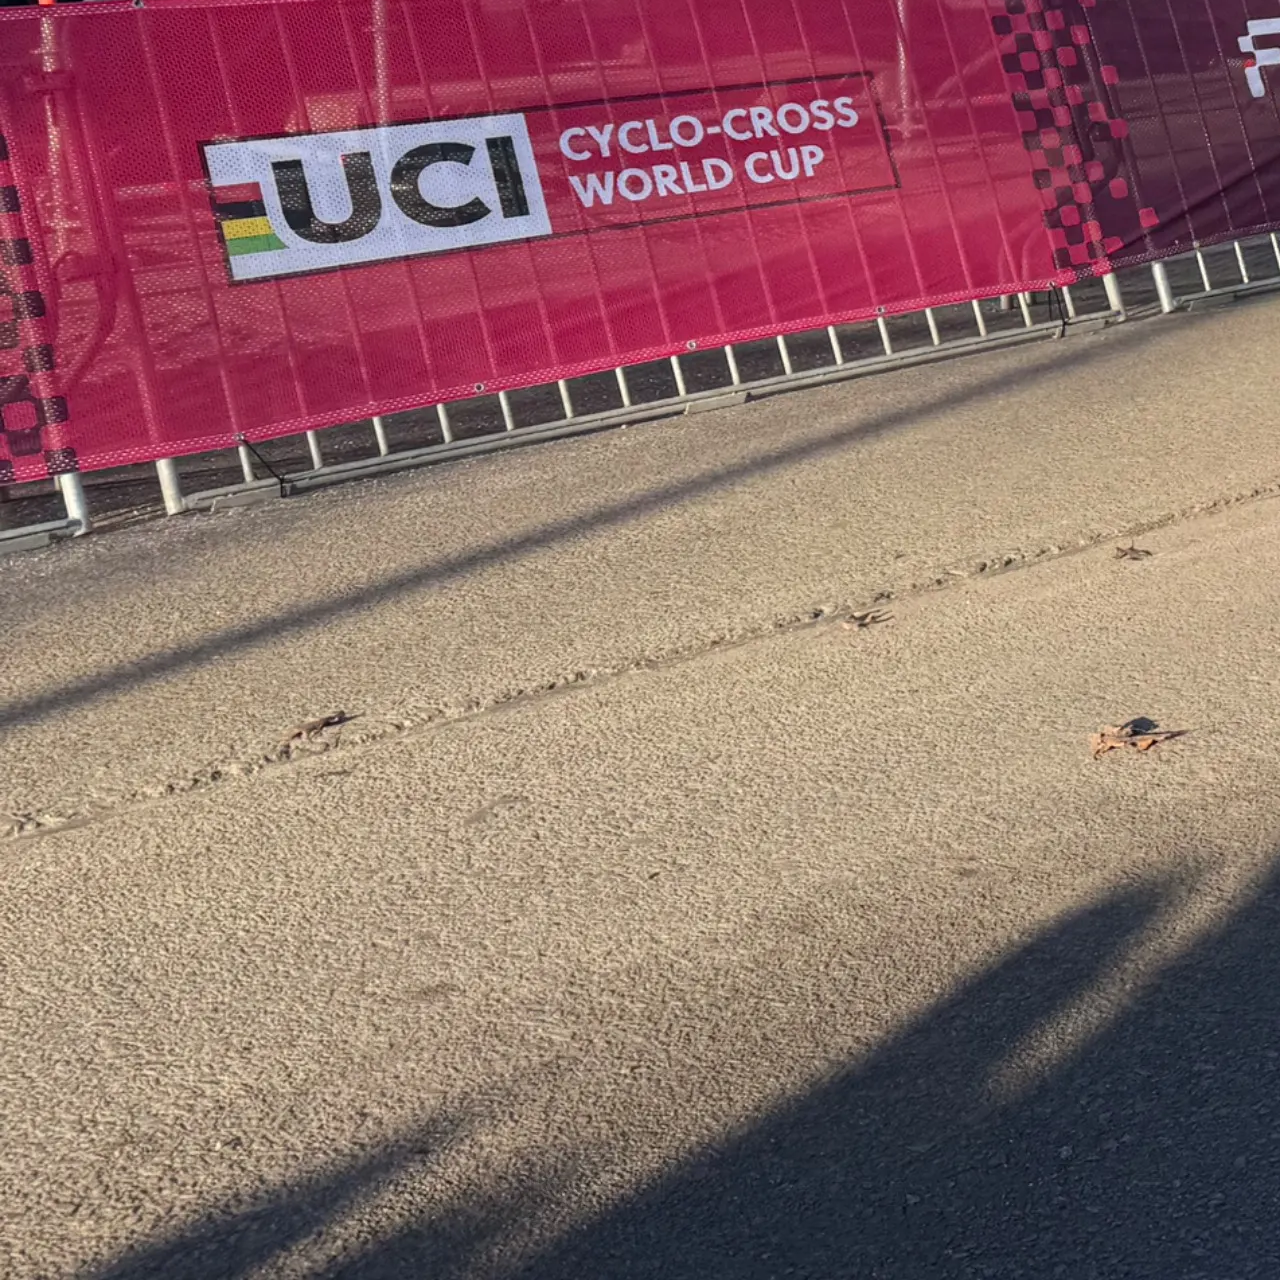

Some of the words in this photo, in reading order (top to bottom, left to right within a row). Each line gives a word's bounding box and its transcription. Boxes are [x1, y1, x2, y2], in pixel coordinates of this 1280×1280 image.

[558, 96, 860, 163] CYCLO-CROSS
[270, 135, 531, 244] UCI
[568, 159, 735, 209] WORLD
[743, 144, 826, 185] CUP
